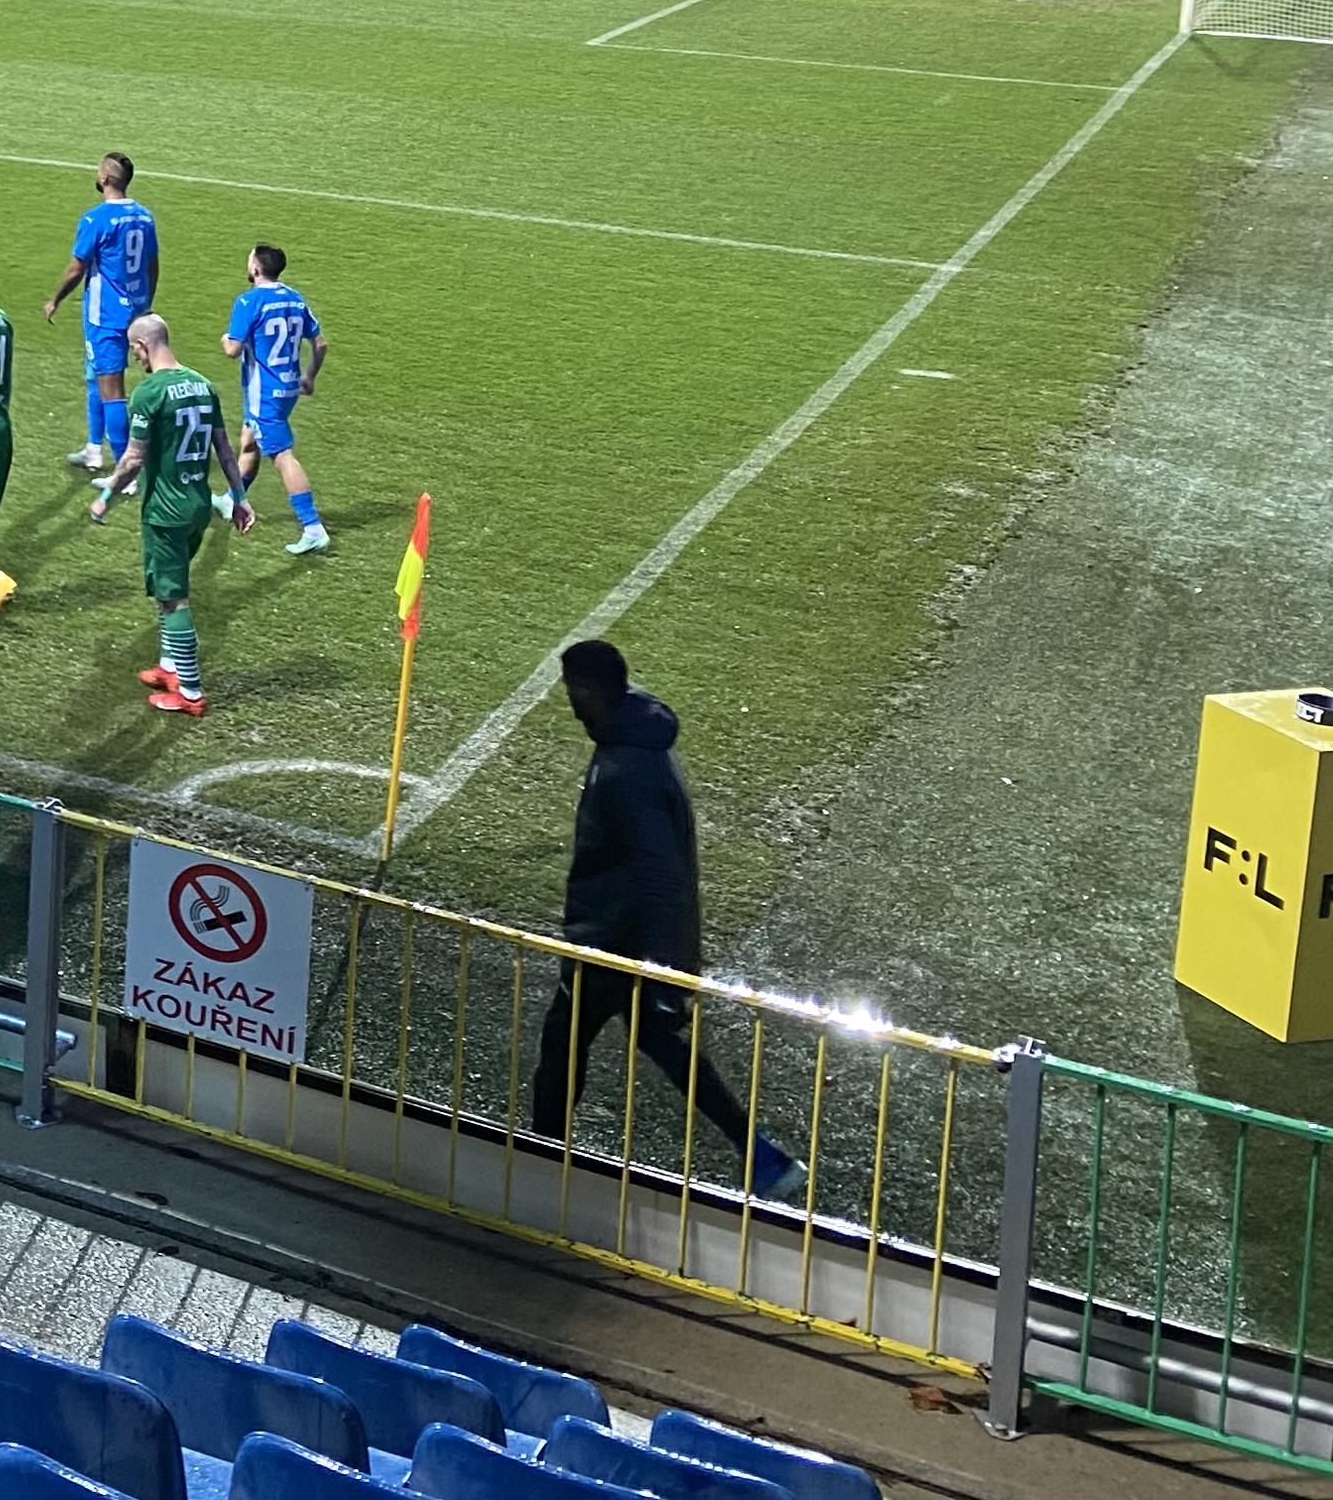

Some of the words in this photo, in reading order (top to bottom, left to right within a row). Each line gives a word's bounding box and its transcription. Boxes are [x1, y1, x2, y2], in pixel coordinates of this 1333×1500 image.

[125, 229, 145, 274] 9
[175, 405, 214, 462] 25
[153, 957, 276, 1014] ZÁKAZ
[132, 985, 297, 1055] KOUŘENÍ
